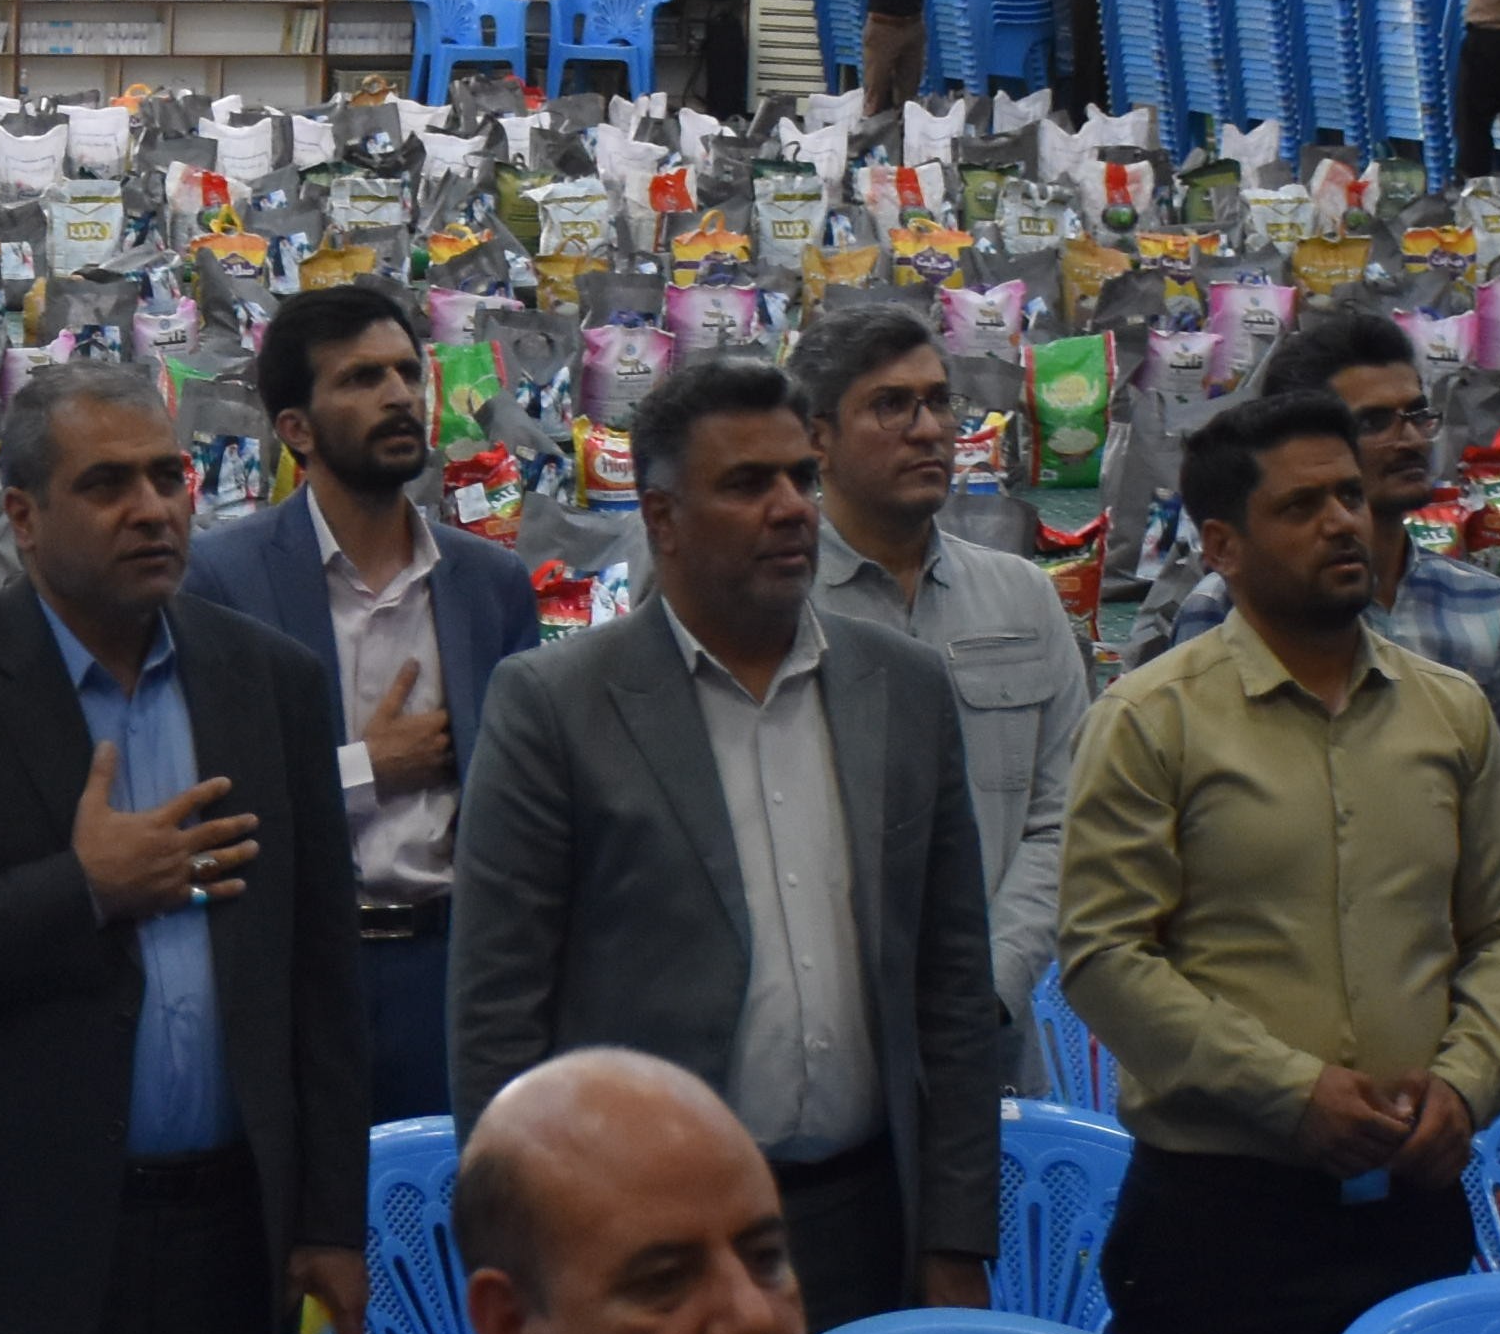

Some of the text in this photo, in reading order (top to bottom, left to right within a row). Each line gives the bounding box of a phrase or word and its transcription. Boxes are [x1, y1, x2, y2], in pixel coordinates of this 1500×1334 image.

[68, 224, 102, 238] LUX
[773, 224, 806, 237] LUX
[153, 330, 187, 347] قلب
